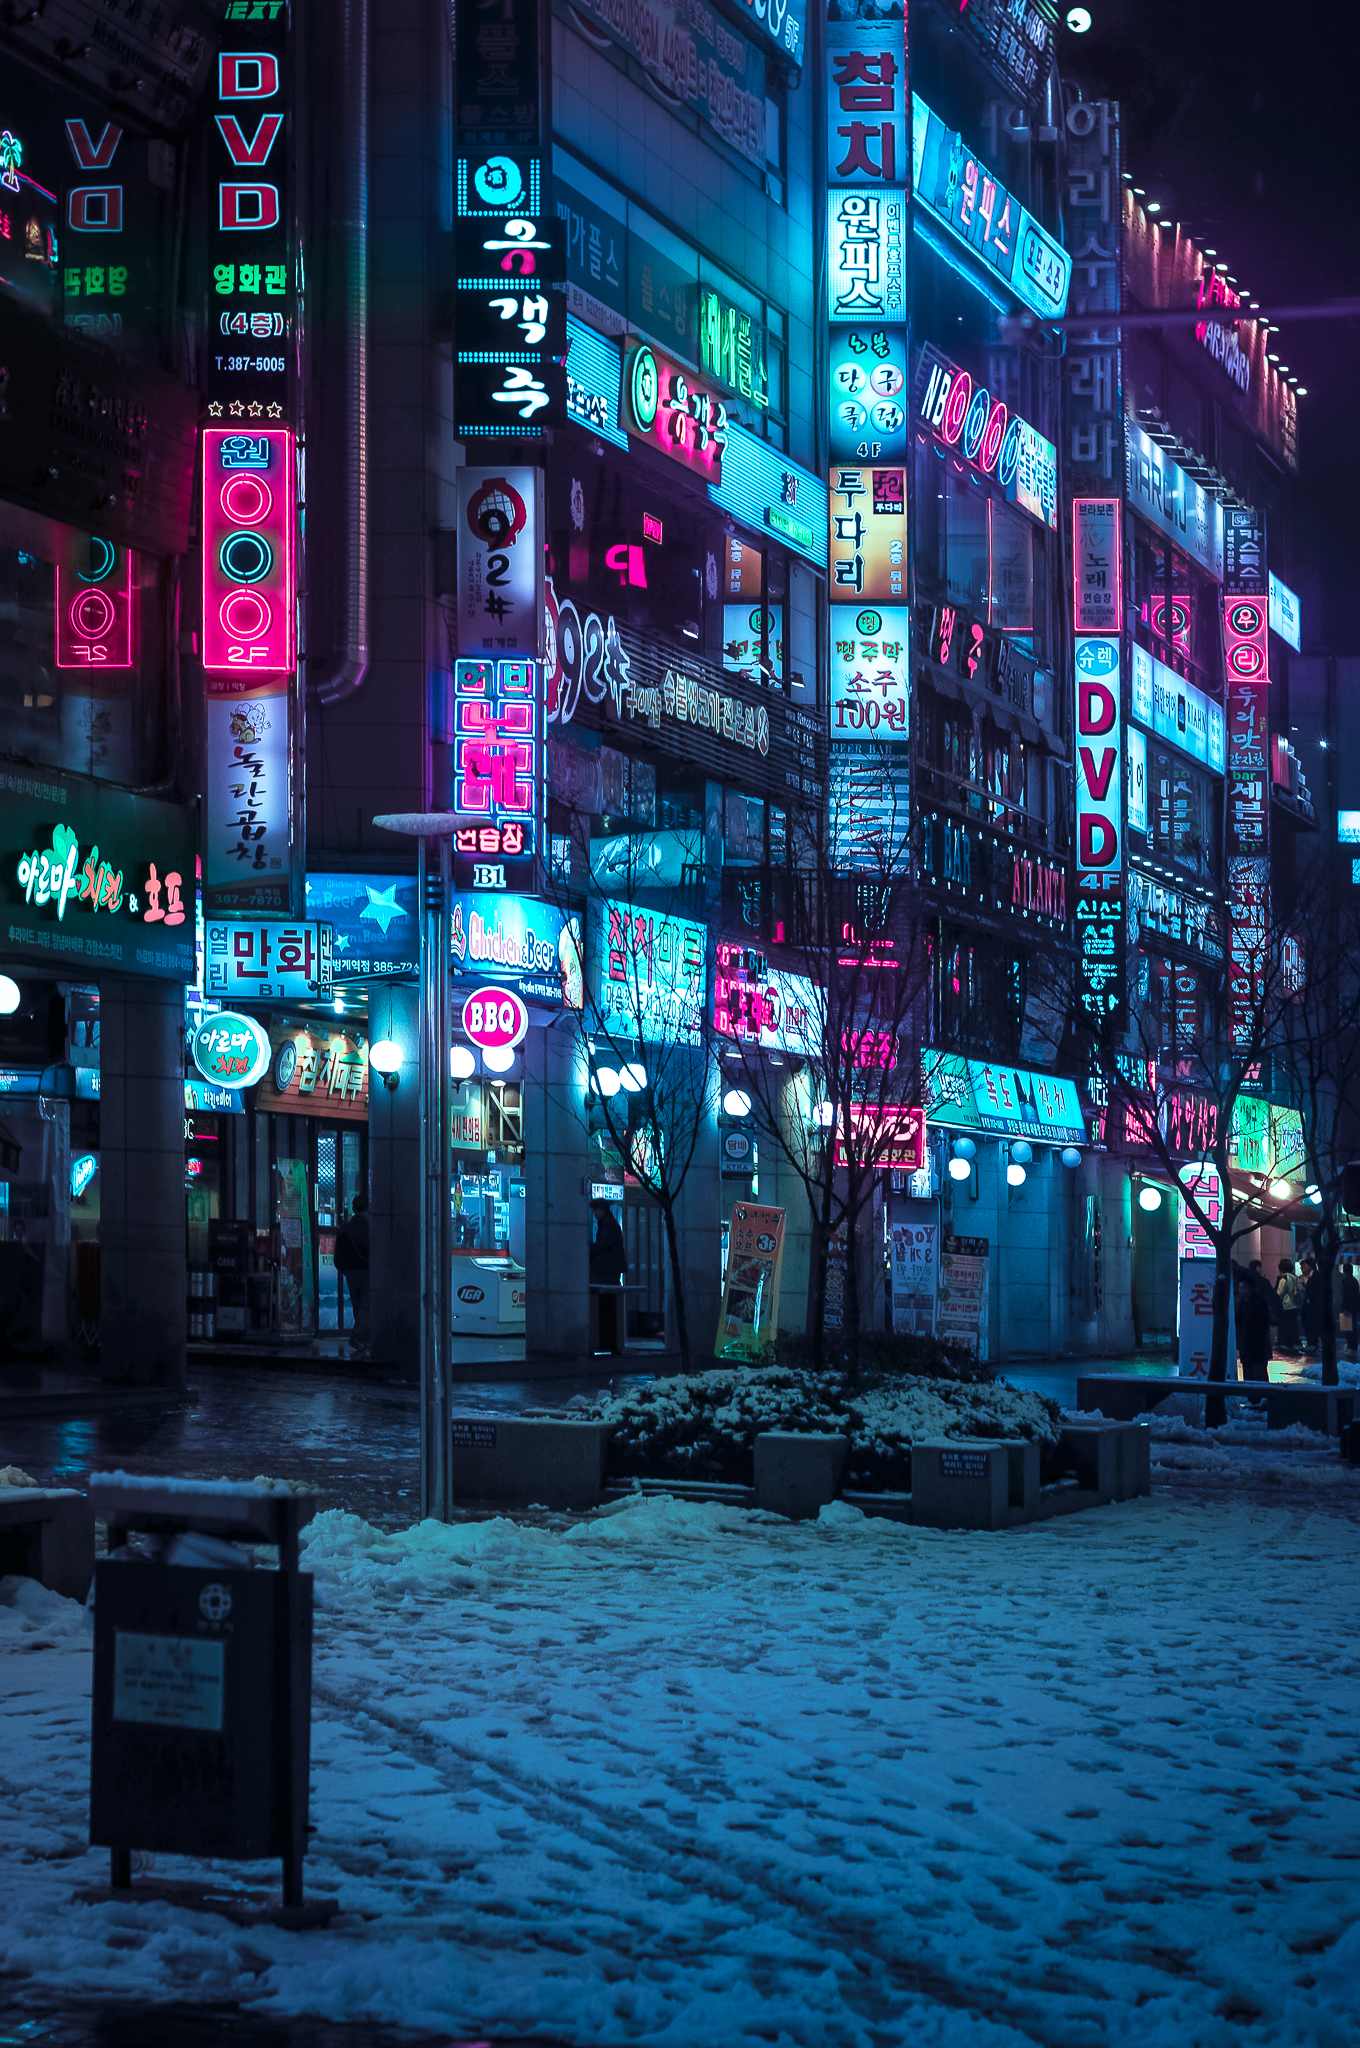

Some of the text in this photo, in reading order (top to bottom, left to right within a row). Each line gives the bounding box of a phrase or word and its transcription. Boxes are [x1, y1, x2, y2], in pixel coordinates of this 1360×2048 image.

[785, 14, 799, 52] 5F
[833, 52, 898, 181] 참치
[214, 52, 284, 231] DVD
[960, 158, 1010, 256] 원피스
[833, 195, 885, 316] 원피스
[214, 264, 287, 295] 영화관
[220, 313, 284, 337] (4층)
[215, 356, 286, 372] T.387-5005
[838, 368, 898, 393] 당구
[841, 405, 899, 431] 클럽
[219, 435, 270, 469] 원
[857, 441, 882, 458] 4F
[1078, 504, 1114, 517] 브라보존
[833, 470, 868, 594] 투다리
[1085, 553, 1110, 589] 노래
[1083, 592, 1112, 605] 연습장
[835, 641, 904, 663] 땡주막
[1236, 608, 1256, 671] 우리
[228, 646, 270, 664] 2F
[1078, 647, 1113, 671] 슈렉
[845, 669, 898, 698] 소주
[834, 698, 907, 732] 100원
[464, 701, 516, 805] 노래
[832, 743, 893, 755] BEER BAR
[1078, 681, 1119, 868] DVD
[1232, 771, 1256, 781] bar
[473, 863, 507, 888] B1
[1012, 854, 1067, 923] ATLANTA
[1080, 874, 1121, 891] 4F
[129, 893, 139, 913] &
[143, 862, 186, 926] 호프
[1076, 899, 1122, 921] 신선
[208, 926, 229, 992] 열린
[233, 928, 317, 981] 만화
[333, 958, 371, 973] 범계역점
[258, 983, 287, 998] B1
[469, 1000, 516, 1035] BBQ
[215, 1054, 250, 1077] 치킨
[984, 1068, 1013, 1112] 독도
[727, 1139, 747, 1151] 담배
[757, 1233, 776, 1251] 3F
[459, 1286, 483, 1300] IGA
